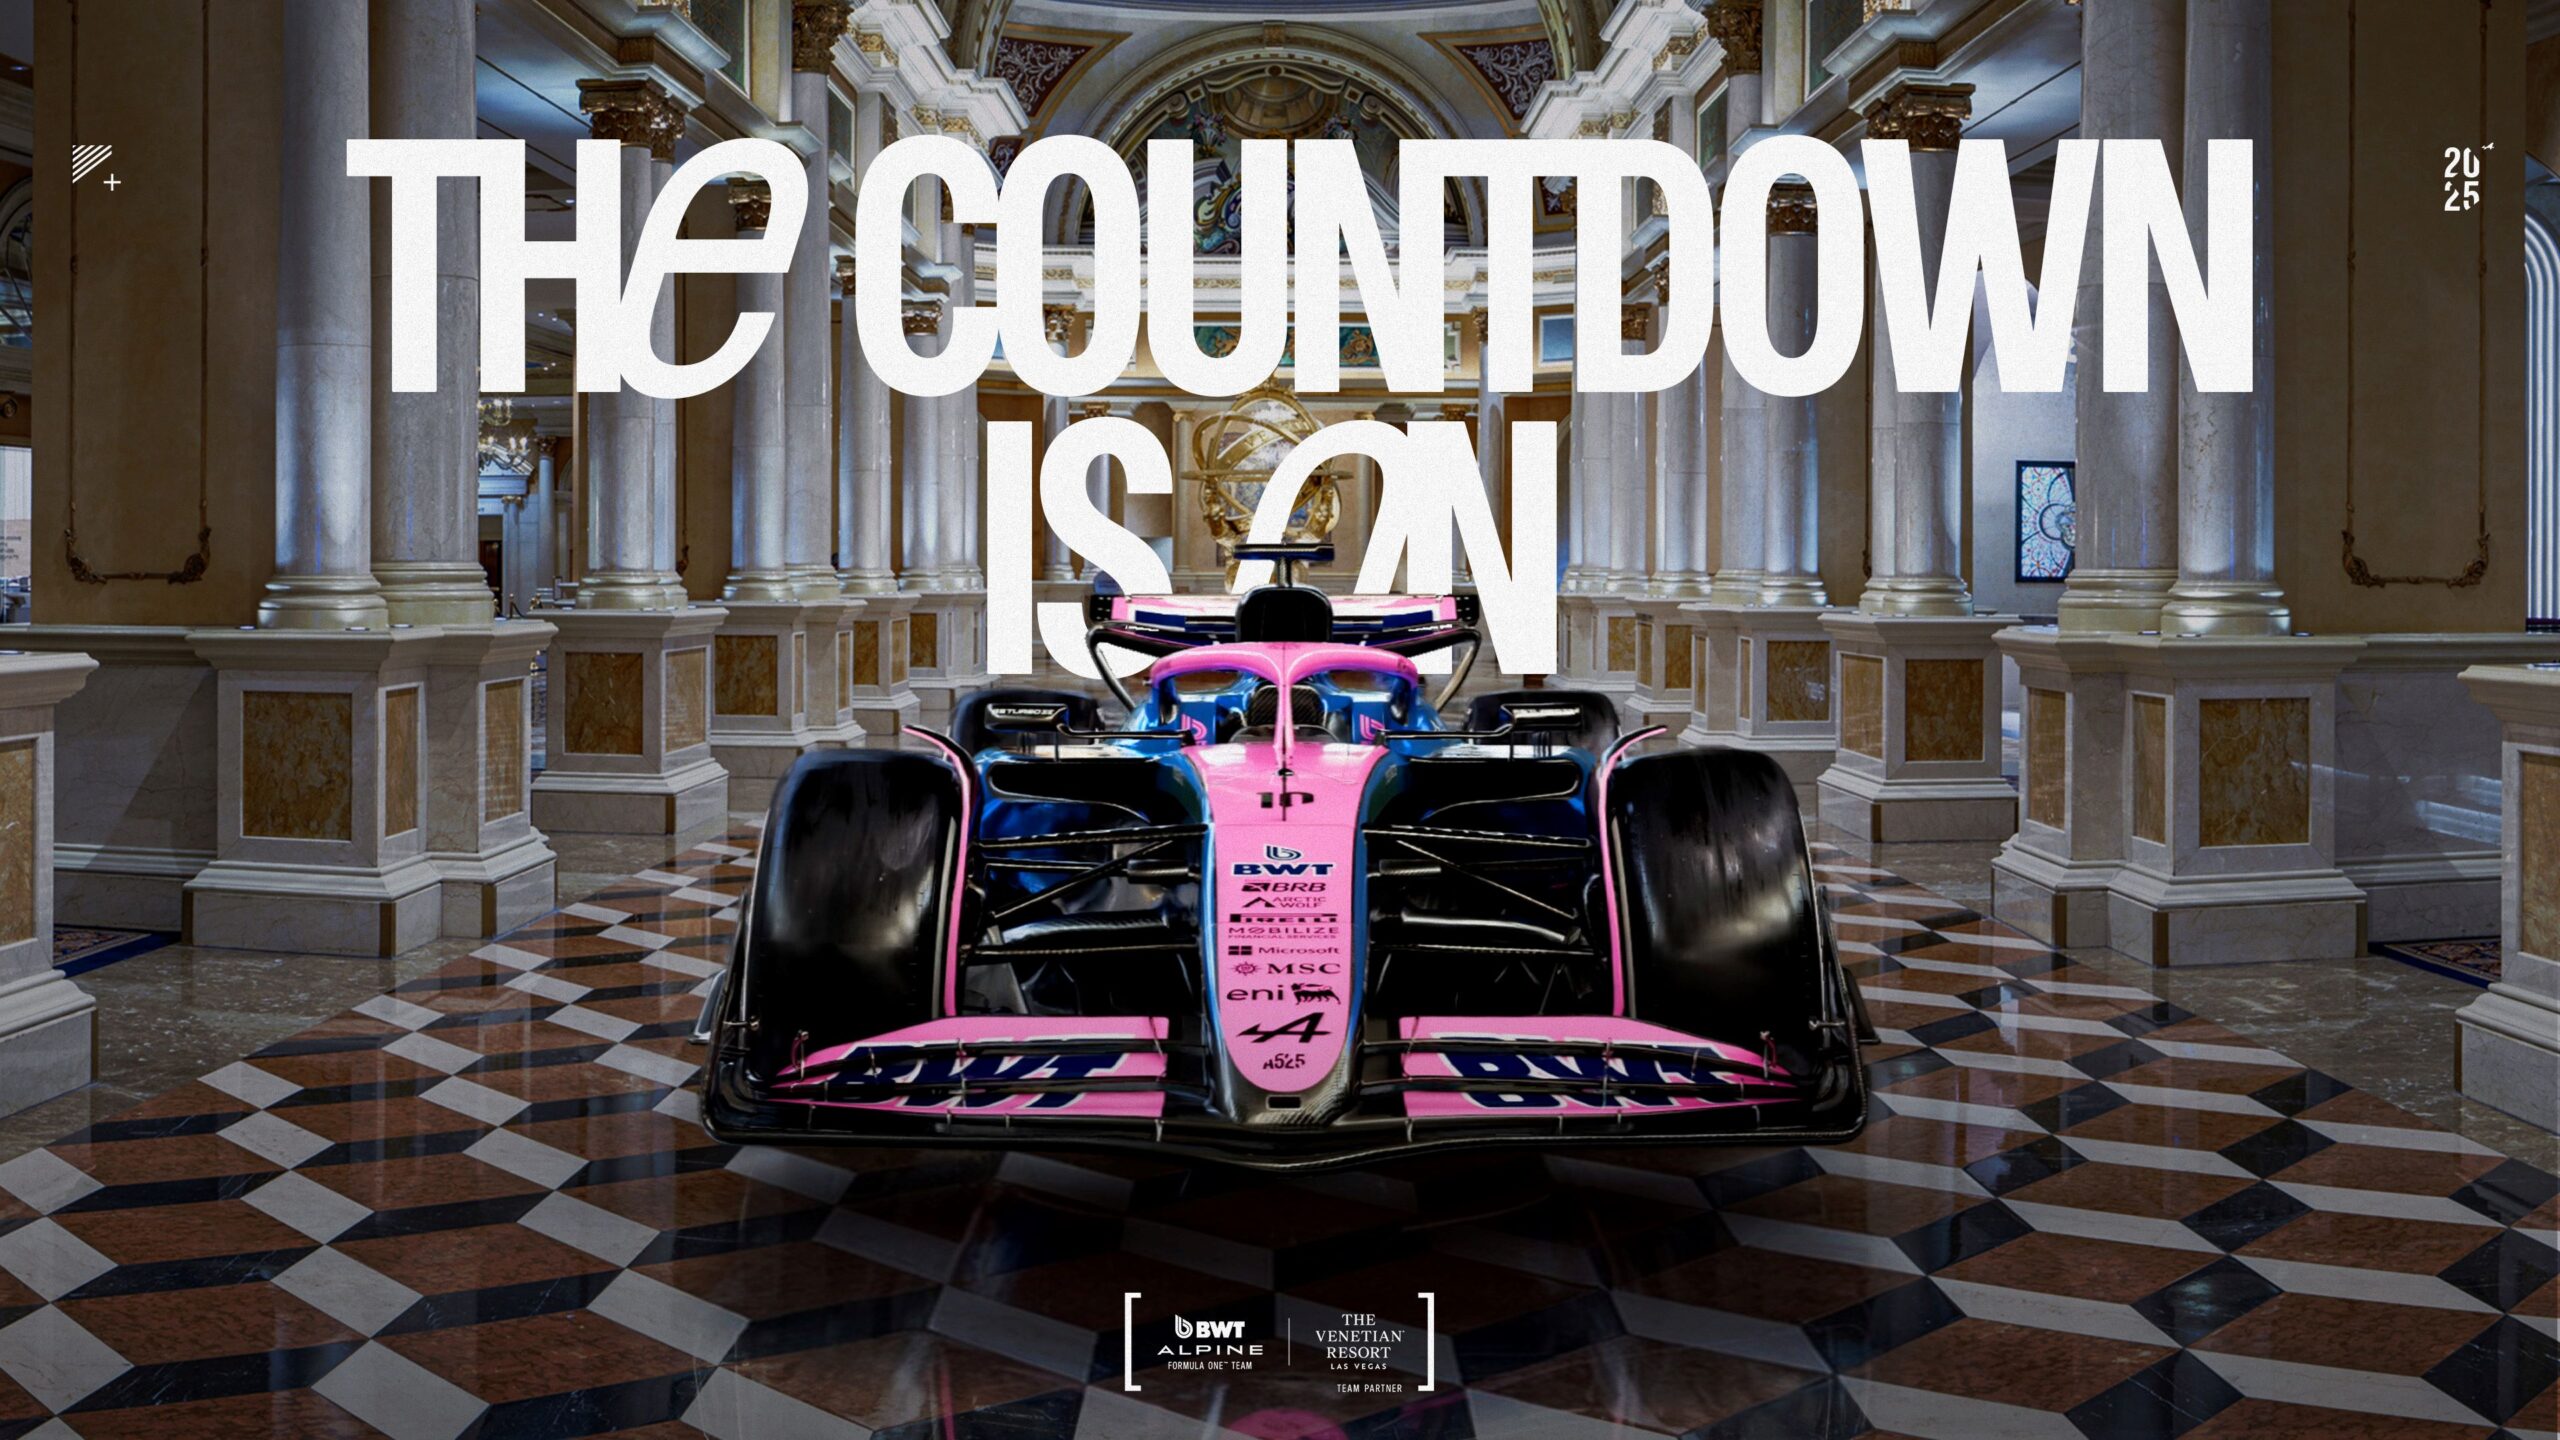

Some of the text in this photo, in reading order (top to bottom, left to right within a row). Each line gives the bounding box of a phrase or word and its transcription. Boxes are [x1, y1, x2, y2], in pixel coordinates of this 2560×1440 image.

[1233, 863, 1334, 876] BWT
[1272, 882, 1327, 892] BRB
[1229, 913, 1338, 924] PIRELLI
[1258, 946, 1340, 955] Microsoft
[1267, 962, 1341, 975] MSC
[1226, 984, 1284, 1001] eni
